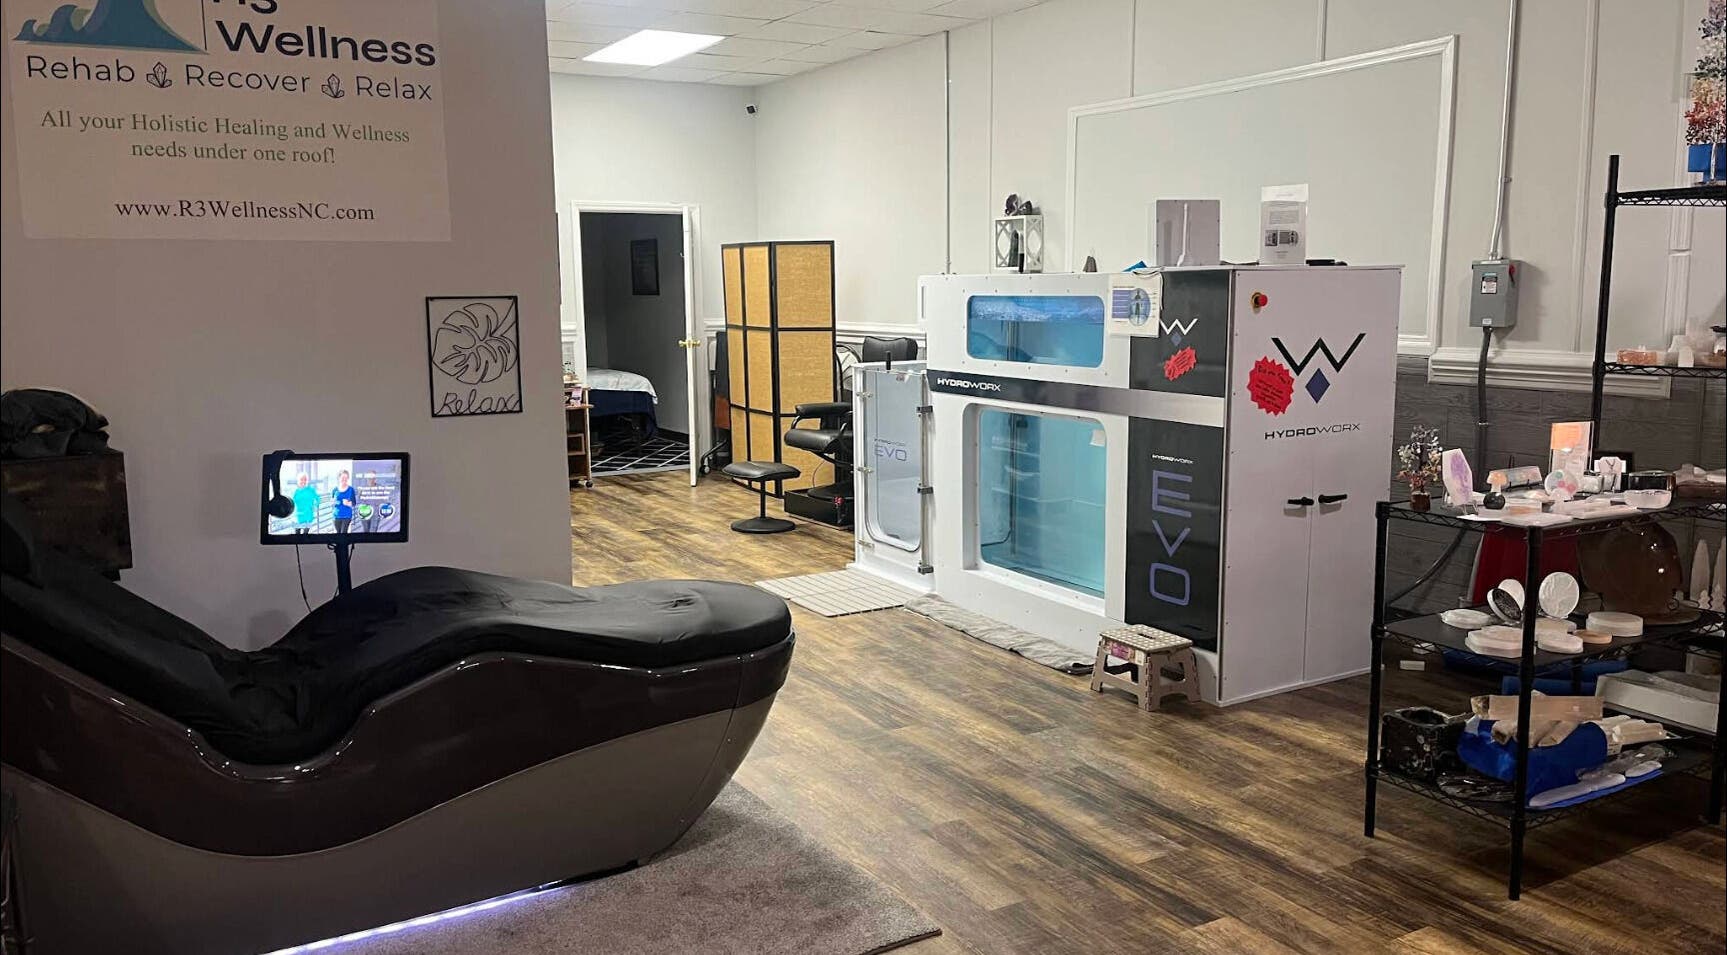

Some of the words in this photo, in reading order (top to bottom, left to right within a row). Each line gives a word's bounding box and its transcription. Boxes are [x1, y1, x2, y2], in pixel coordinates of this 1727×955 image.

[215, 20, 436, 67] Wellness
[26, 55, 136, 82] Rehab
[185, 64, 310, 93] Recover
[355, 75, 432, 100] Relax
[41, 110, 72, 128] All
[79, 114, 125, 132] your
[131, 113, 209, 134] Holistic
[215, 117, 289, 141] Healing
[294, 123, 326, 139] and
[332, 123, 410, 143] Wellness
[131, 141, 187, 158] needs
[194, 142, 248, 160] under
[253, 147, 286, 161] one
[292, 146, 336, 164] roof!
[114, 199, 375, 221] www.R3WellnessNC.com
[936, 377, 1002, 392] HYDROWORX
[437, 389, 520, 414] Relax
[1264, 423, 1361, 440] HYDROWORX
